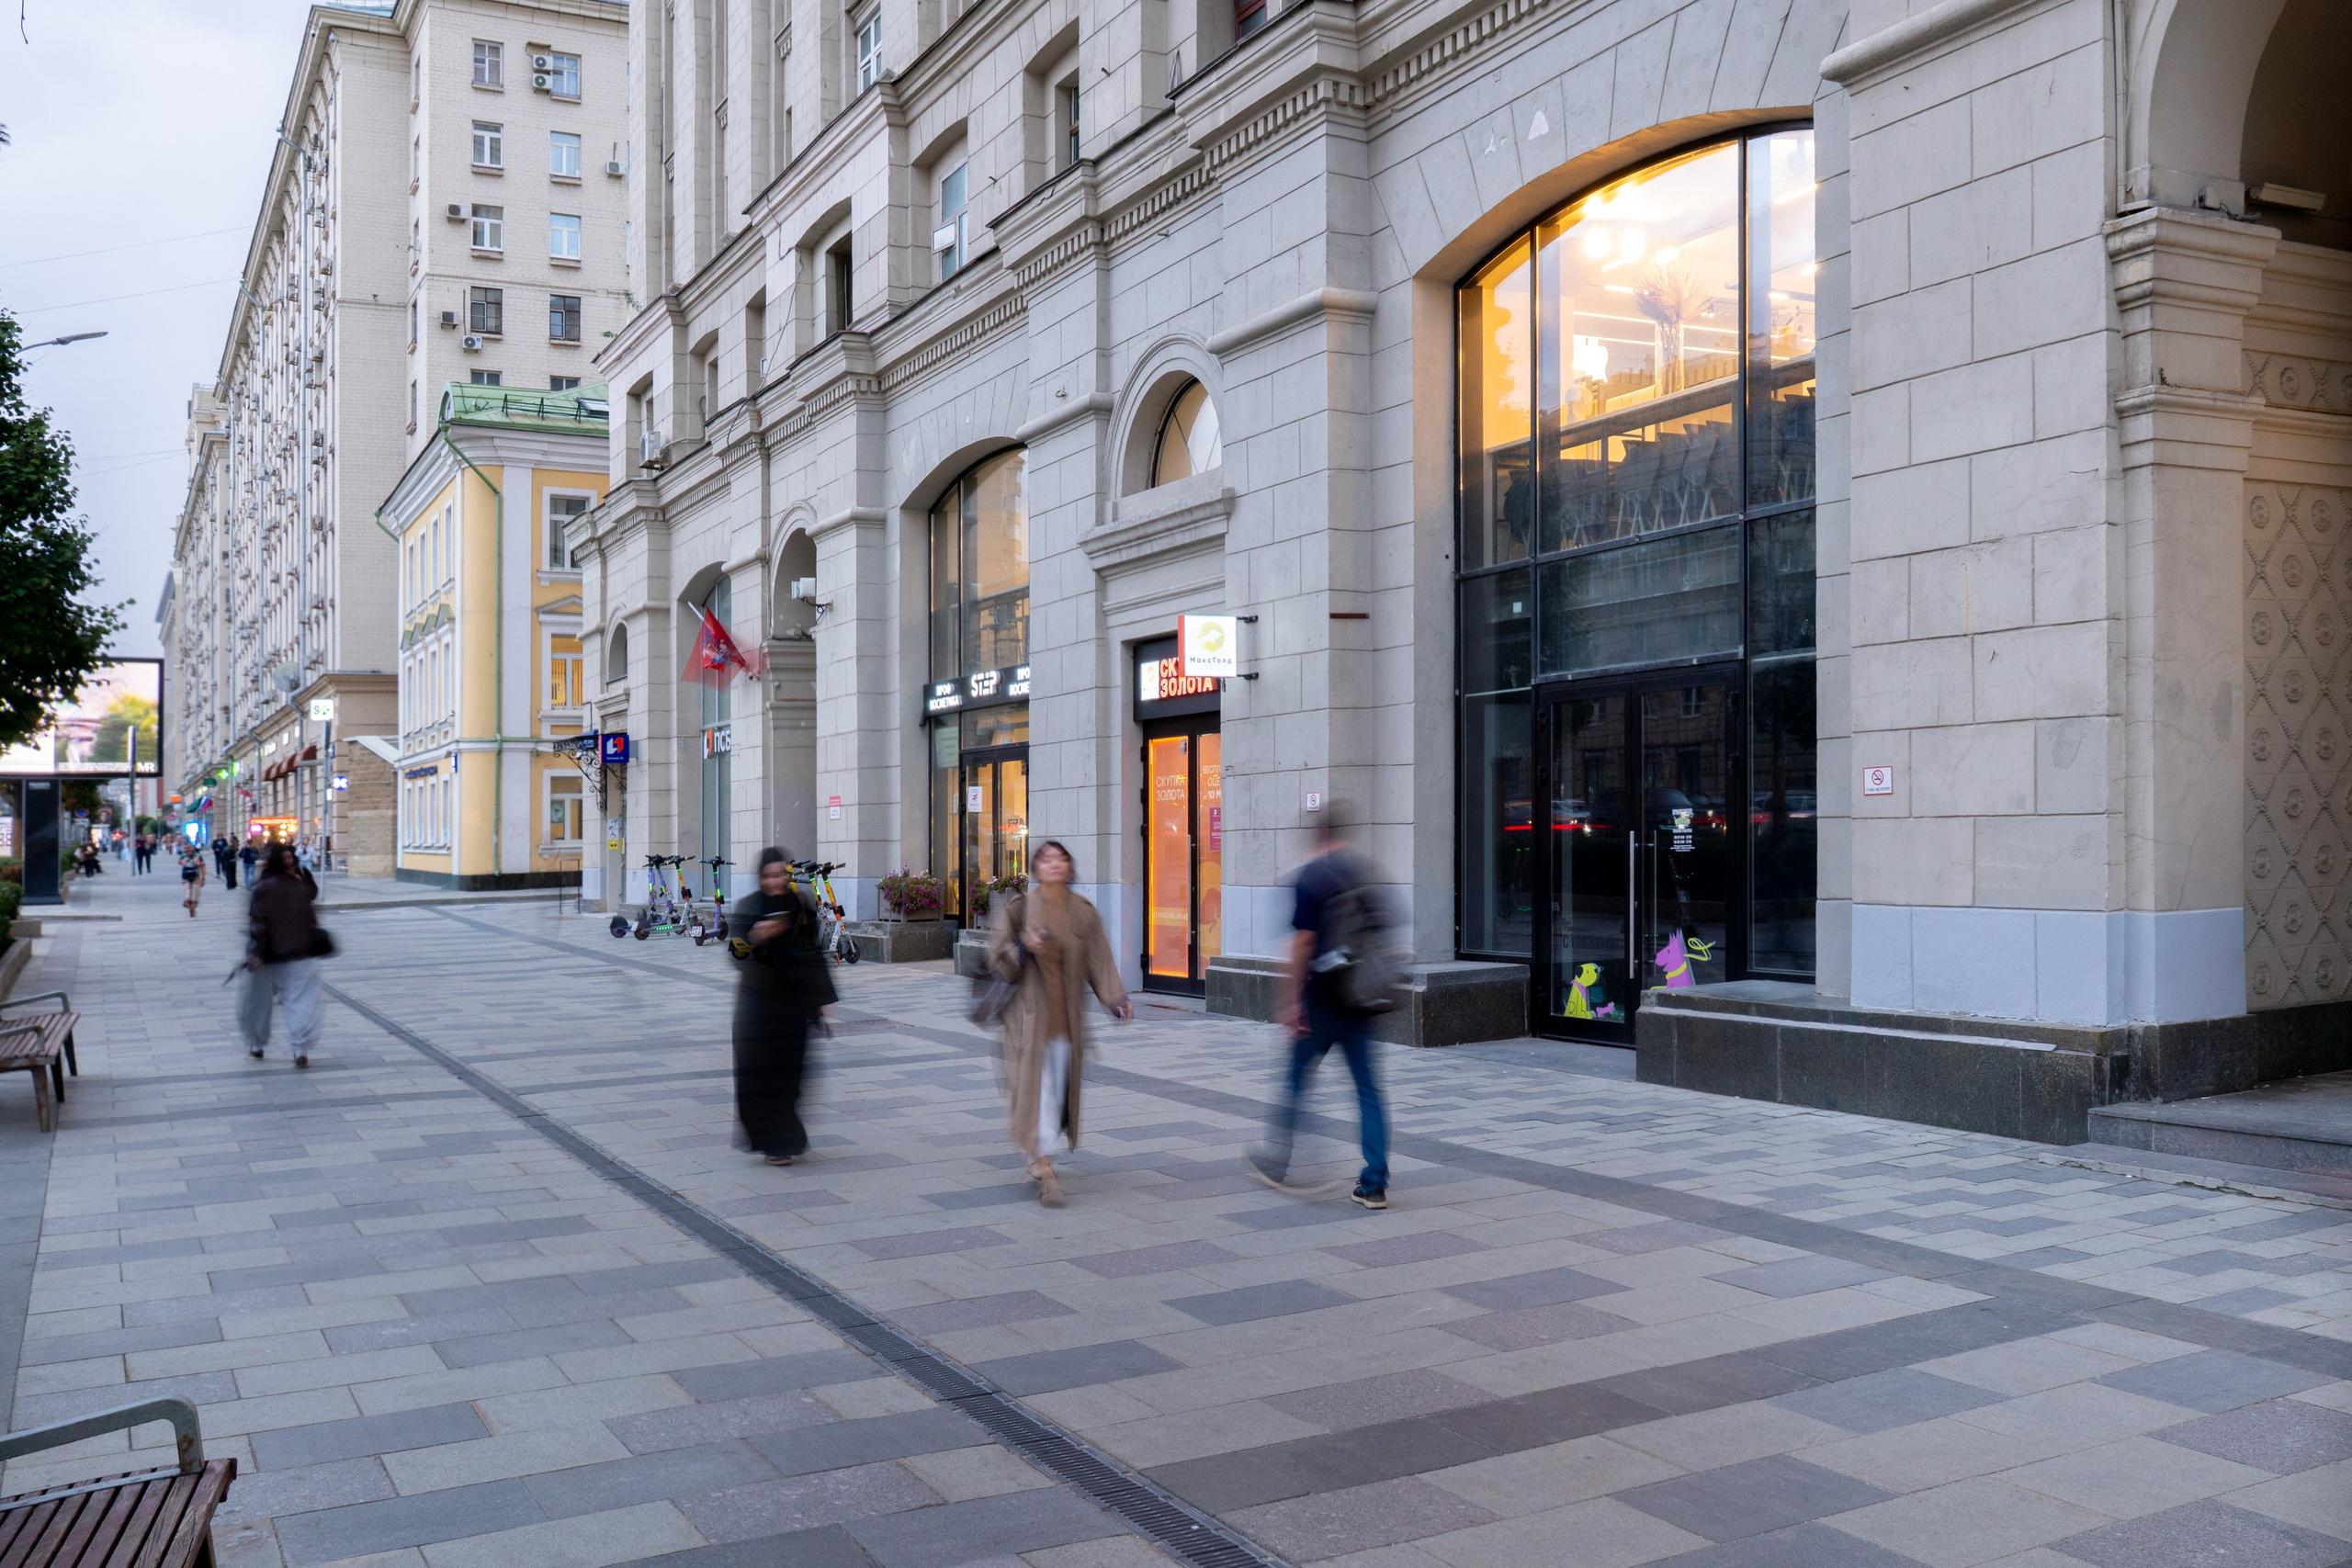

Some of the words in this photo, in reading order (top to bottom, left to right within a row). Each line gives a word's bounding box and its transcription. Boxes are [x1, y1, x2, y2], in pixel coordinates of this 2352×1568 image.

[1017, 667, 1030, 681] ПРО
[1160, 658, 1179, 677] СК
[971, 671, 998, 697] STEP
[1010, 682, 1030, 696] КОСМЕ
[1160, 677, 1213, 697] ЗОЛОТА
[714, 730, 730, 753] ПСБ
[1203, 765, 1220, 774] БЕСПЛ
[1156, 774, 1185, 787] СКУПКА
[1207, 777, 1220, 786] ОЦЕ
[1156, 789, 1185, 801] ЗОЛОТА
[1216, 791, 1221, 799] М
